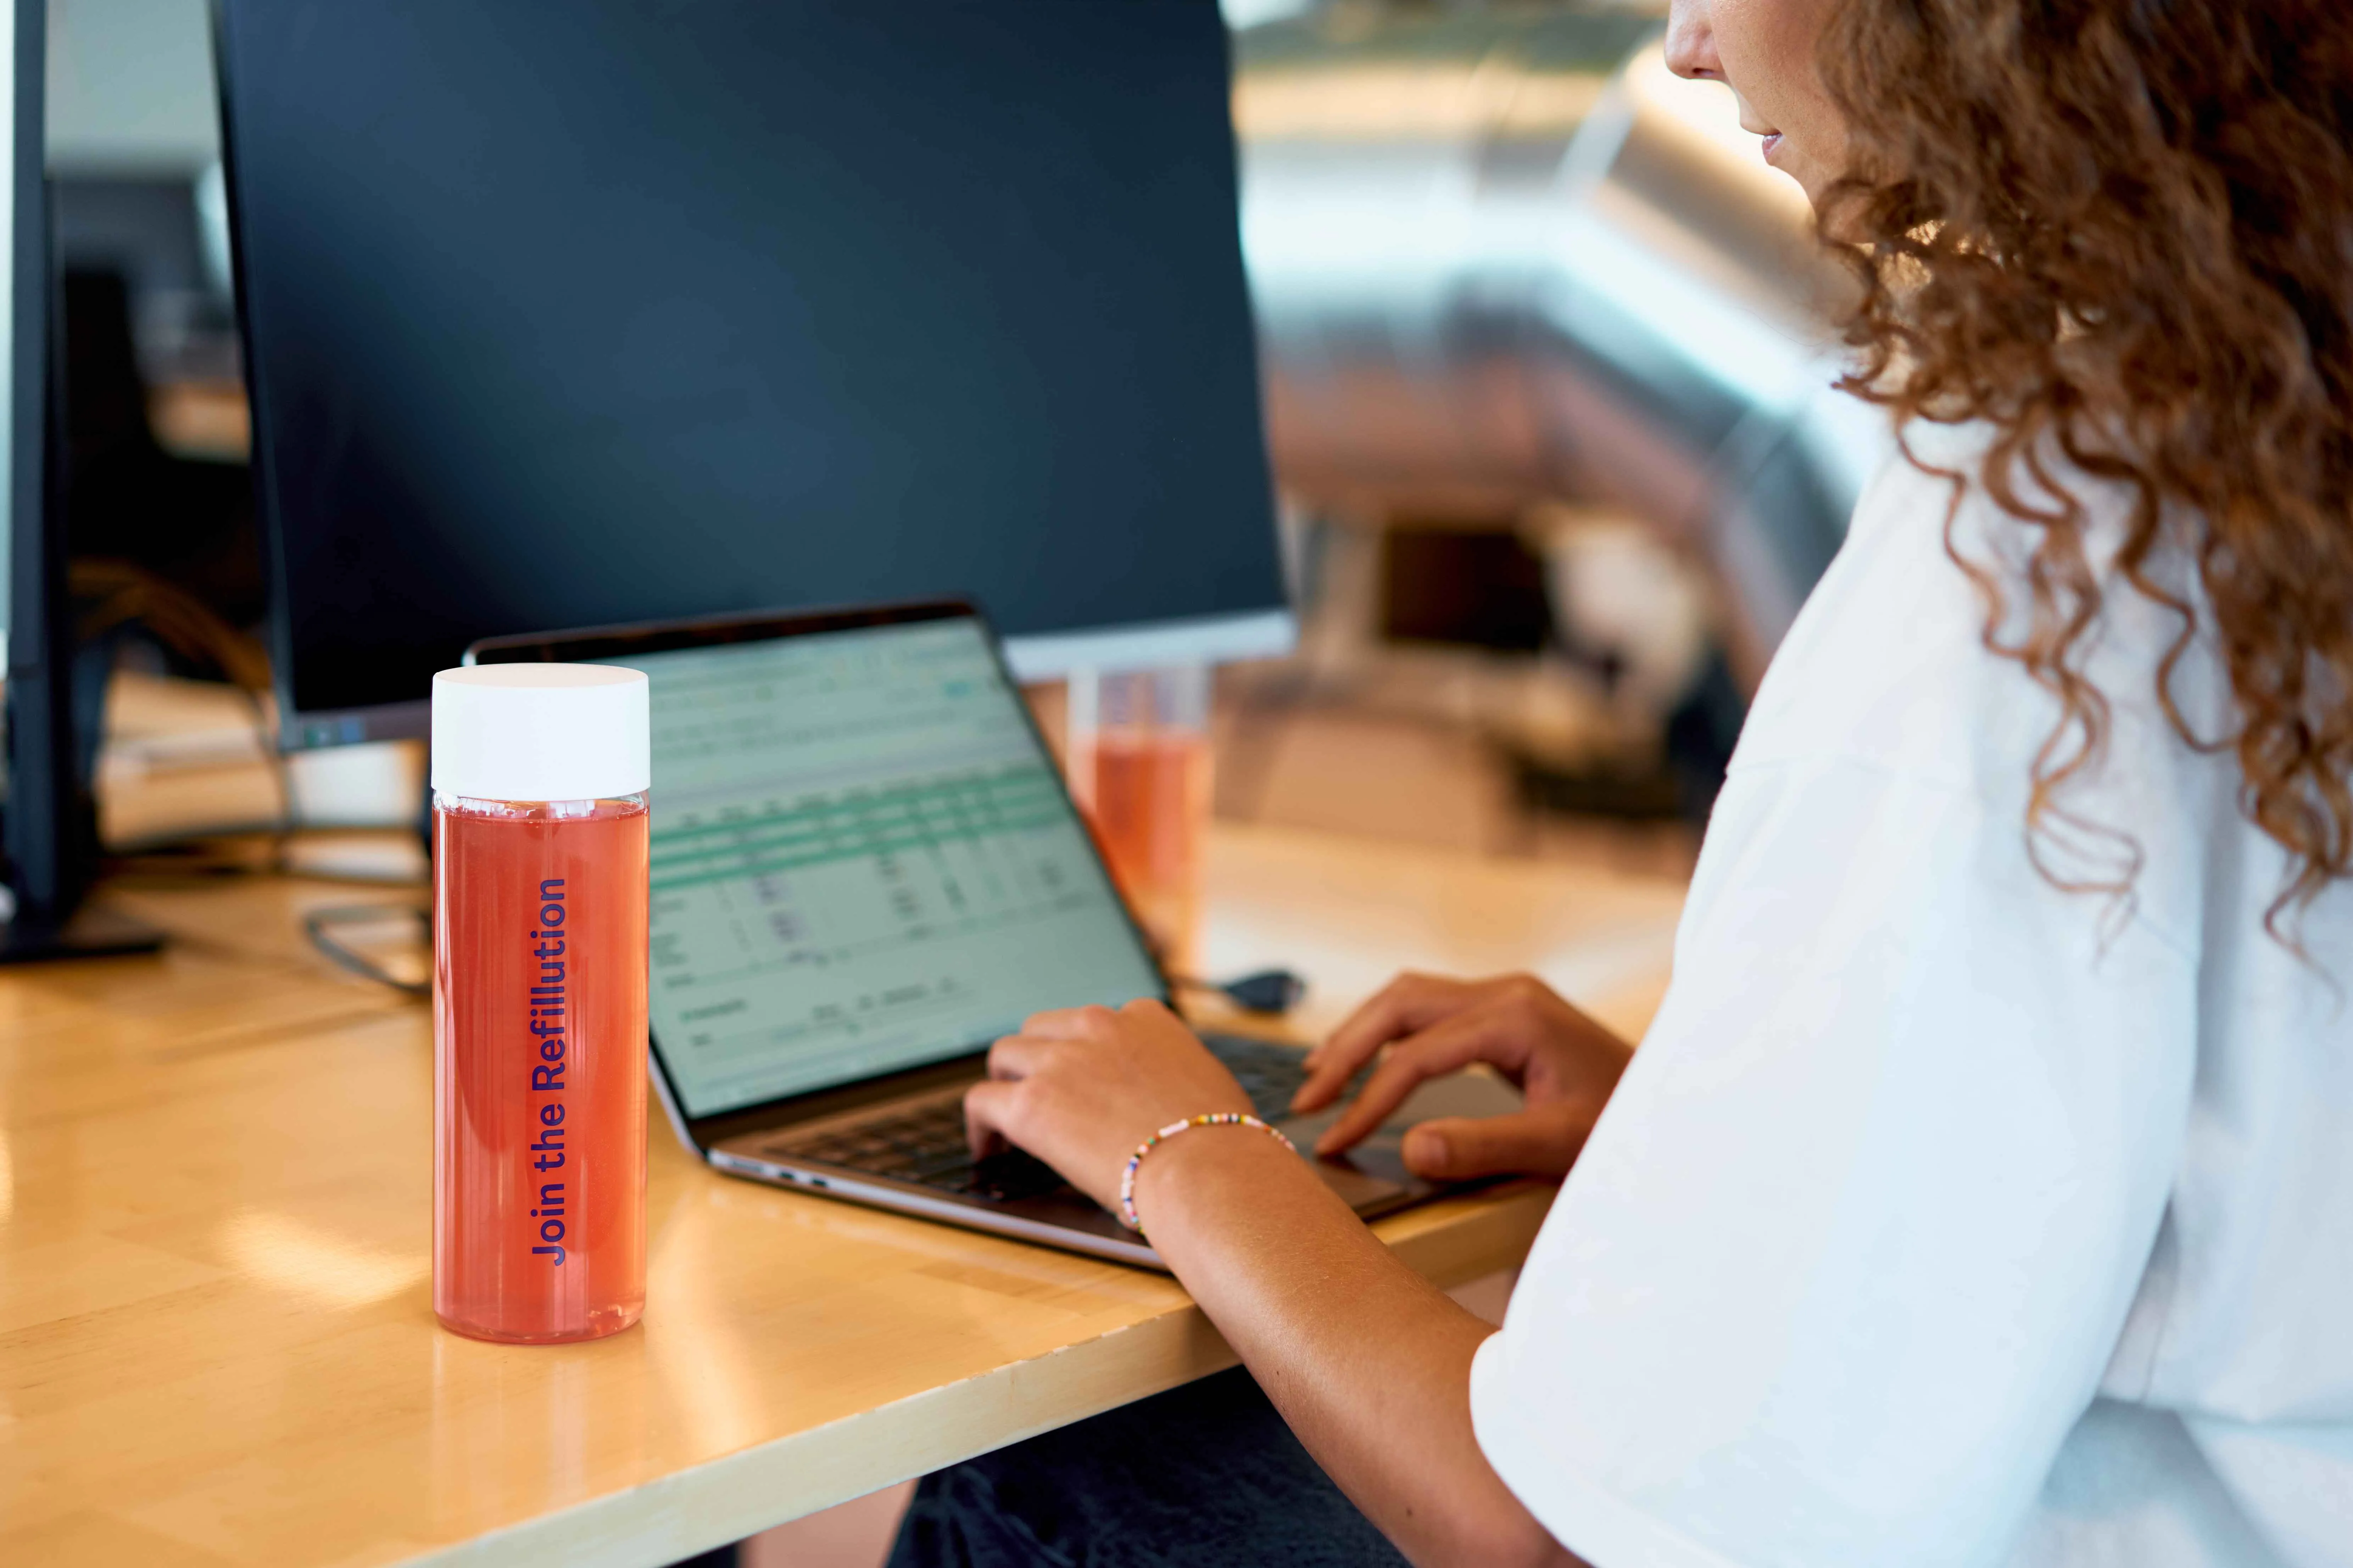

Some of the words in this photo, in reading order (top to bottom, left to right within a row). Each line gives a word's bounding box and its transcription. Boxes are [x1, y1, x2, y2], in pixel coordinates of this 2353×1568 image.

[530, 879, 566, 1091] Refillution
[531, 1104, 566, 1172] the
[530, 1183, 566, 1266] Join
